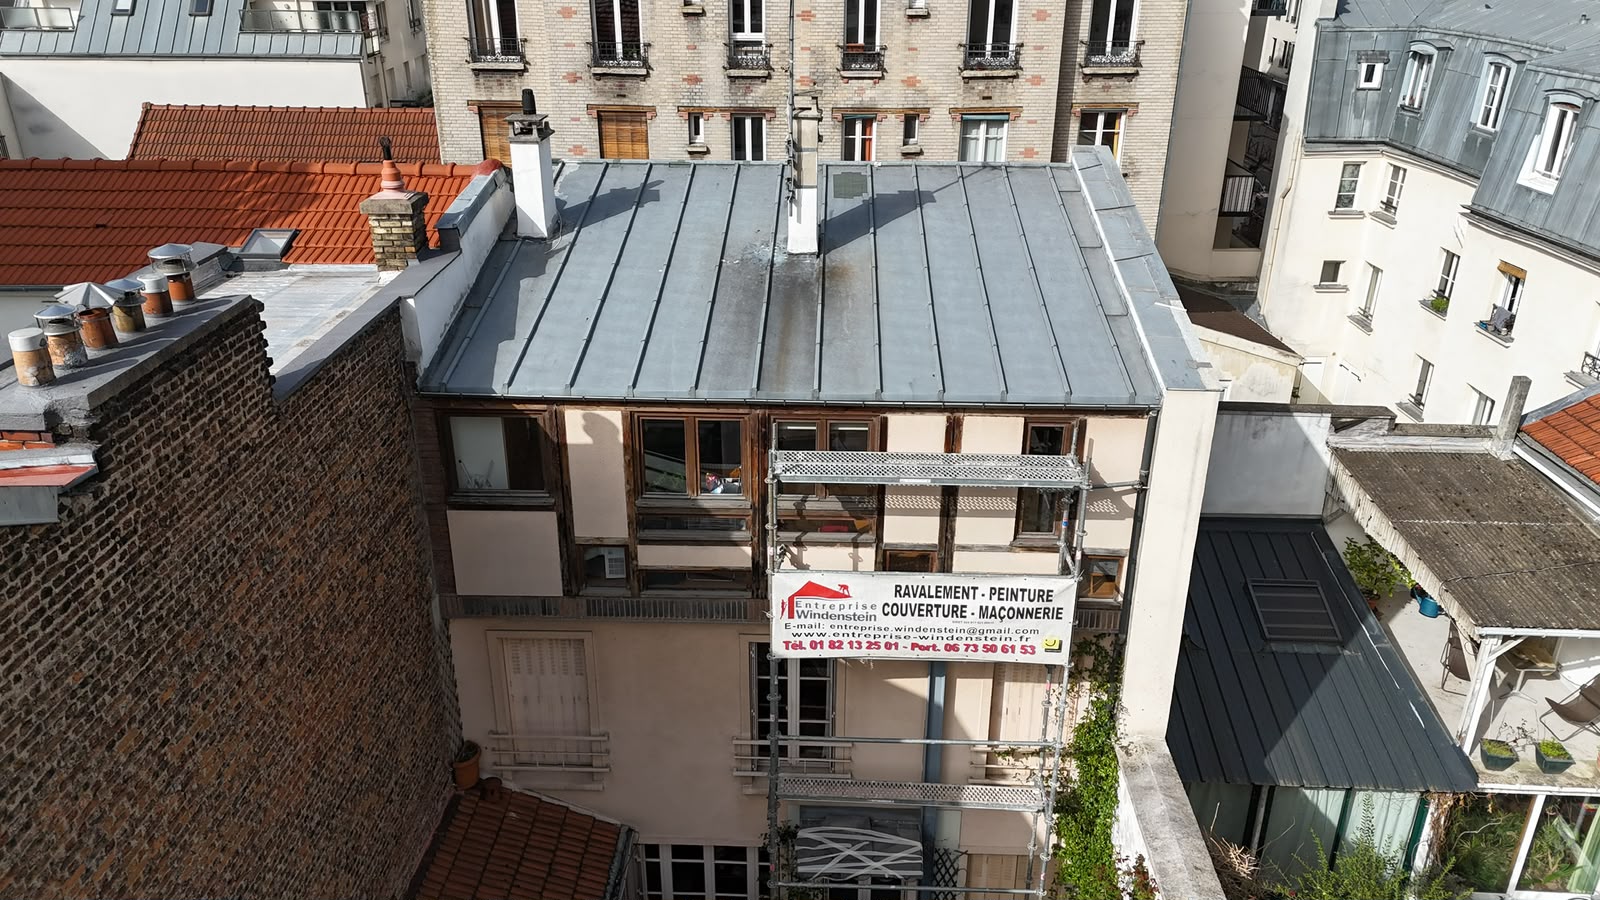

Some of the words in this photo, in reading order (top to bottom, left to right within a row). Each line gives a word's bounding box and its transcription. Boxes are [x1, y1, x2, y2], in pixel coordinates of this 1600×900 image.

[894, 584, 979, 600] RAVALEMENT
[989, 586, 1054, 603] PEINTURE
[795, 600, 877, 611] Entreprise
[796, 609, 877, 622] Windenstein
[882, 602, 968, 619] COUVERTURE
[978, 605, 1064, 623] MAÇONNERIE
[784, 622, 825, 630] E-mail:
[829, 624, 1040, 635] entreprise.windenstein@gmail.com
[791, 632, 1031, 642] www.entreprise-windenstein.fr
[783, 640, 805, 650] Tél.
[809, 640, 824, 650] 01
[828, 640, 844, 650] 82
[848, 640, 863, 650] 13
[865, 640, 881, 651] 25
[884, 641, 899, 651] 01
[910, 642, 941, 652] Port.
[944, 643, 961, 653] 06
[963, 643, 979, 653] 73
[981, 643, 998, 654] 50
[1001, 644, 1016, 654] 61
[1020, 644, 1036, 655] 53
